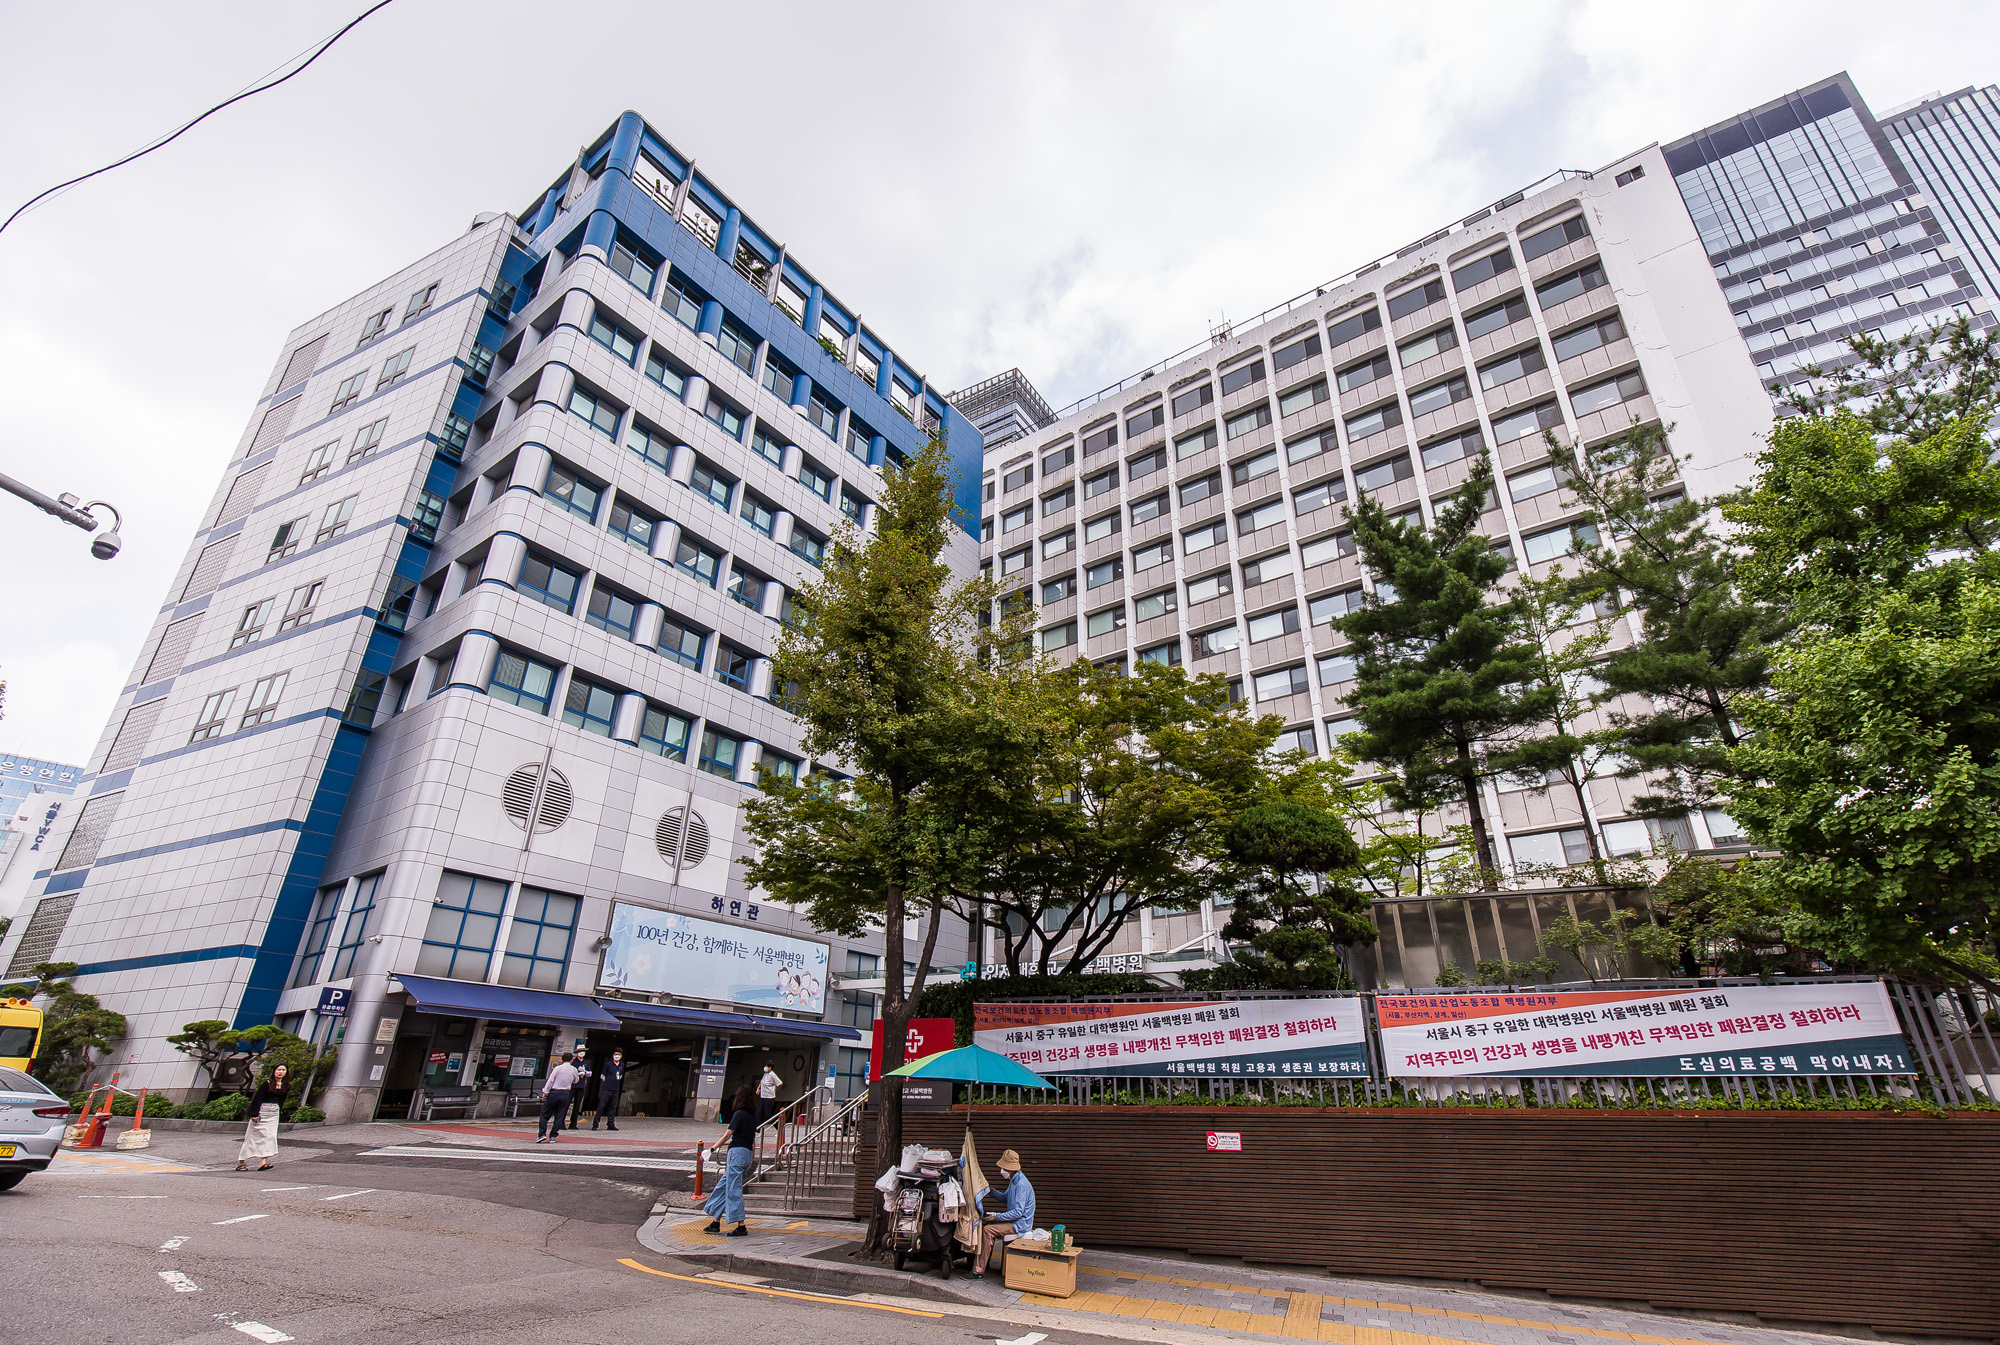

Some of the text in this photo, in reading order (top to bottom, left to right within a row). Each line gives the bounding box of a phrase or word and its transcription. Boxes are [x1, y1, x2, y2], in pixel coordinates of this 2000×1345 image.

[711, 896, 760, 921] 하연관
[636, 925, 805, 969] 100년 건강, 함께하는 서울백병원
[1082, 955, 1143, 975] 울백병원
[330, 990, 344, 1004] P
[1379, 996, 1558, 1009] 전국보건의료산업노동조합 백병원지부
[974, 1006, 1111, 1016] 전국보건의료산업노동조합 백병원지부
[1385, 1011, 1467, 1019] (서울, 부산지역, 상계, 일산)
[1426, 1026, 1462, 1041] 서울시
[1465, 1024, 1490, 1037] 중구
[1493, 1018, 1530, 1033] 유일한
[1533, 1010, 1597, 1029] 대학병원인
[1601, 1001, 1667, 1022] 서울백병원
[1700, 994, 1730, 1010] 철회
[1005, 1030, 1033, 1043] 서울시
[1036, 1029, 1055, 1041] 중구
[1058, 1025, 1087, 1039] 유일한
[1089, 1019, 1139, 1035] 대학병원인
[1142, 1012, 1193, 1029] 서울백병원
[1218, 1006, 1240, 1020] 철회
[1001, 1049, 1043, 1065] 주민의
[1046, 1046, 1080, 1061] 건강과
[1084, 1042, 1119, 1059] 생명을
[1122, 1036, 1172, 1054] 내팽개친
[1175, 1031, 1225, 1049] 무책임한
[1283, 1016, 1337, 1036] 철회하라
[1405, 1047, 1479, 1069] 지역주민의
[1482, 1043, 1528, 1062] 건강과
[1531, 1037, 1578, 1057] 생명을
[1581, 1029, 1646, 1051] 내팽개친
[1649, 1021, 1716, 1043] 무책임한
[1788, 1004, 1862, 1028] 철회하라
[1166, 1061, 1367, 1073] 서울백병원 직원 고용과 생존권 보장하라!
[1679, 1054, 1906, 1072] 도심의료공백 막아내자!
